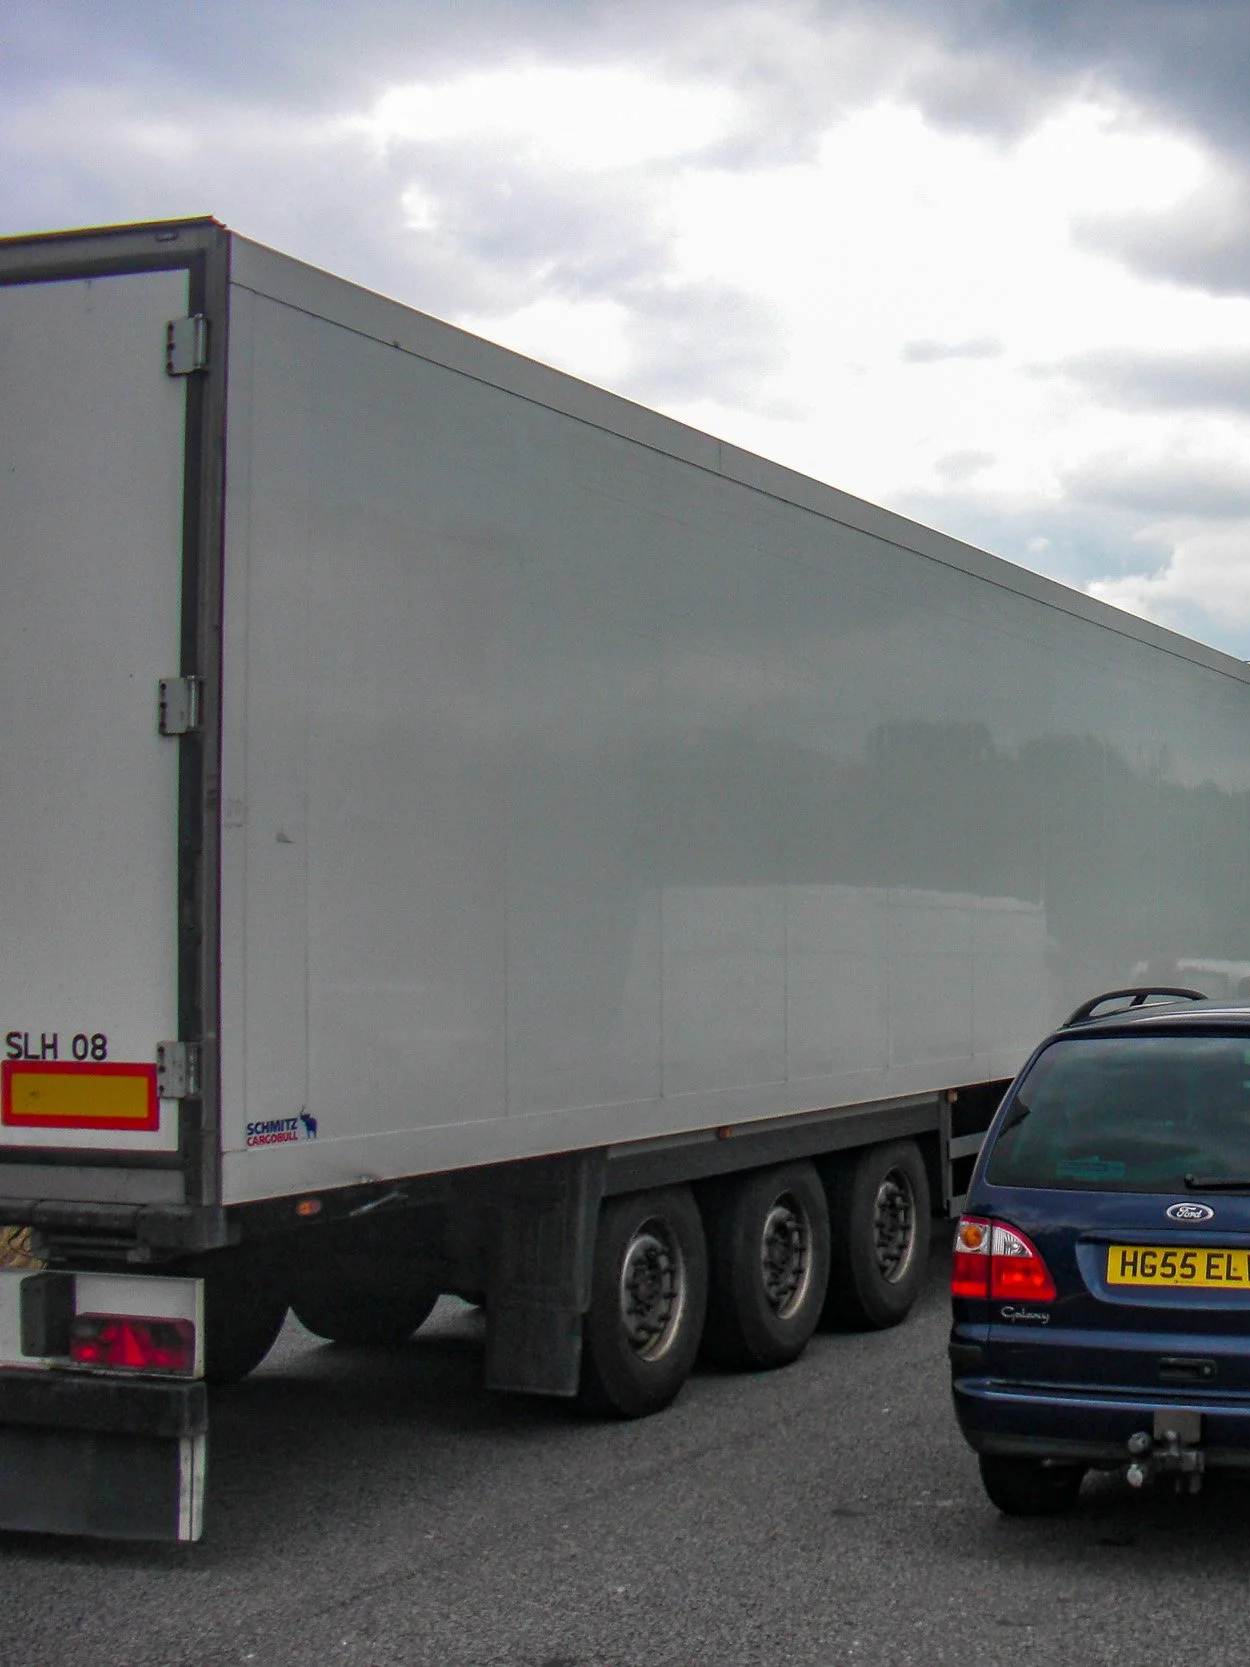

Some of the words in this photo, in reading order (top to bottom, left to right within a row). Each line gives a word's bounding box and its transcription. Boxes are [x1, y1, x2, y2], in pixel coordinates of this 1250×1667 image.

[6, 1031, 58, 1060] SLH
[72, 1033, 107, 1061] 08
[247, 1117, 298, 1136] SCHMITZ
[247, 1131, 298, 1146] CARGOBULL
[1176, 1206, 1203, 1218] Ford
[1120, 1250, 1198, 1279] HG55
[1001, 1306, 1049, 1324] Galaxy
